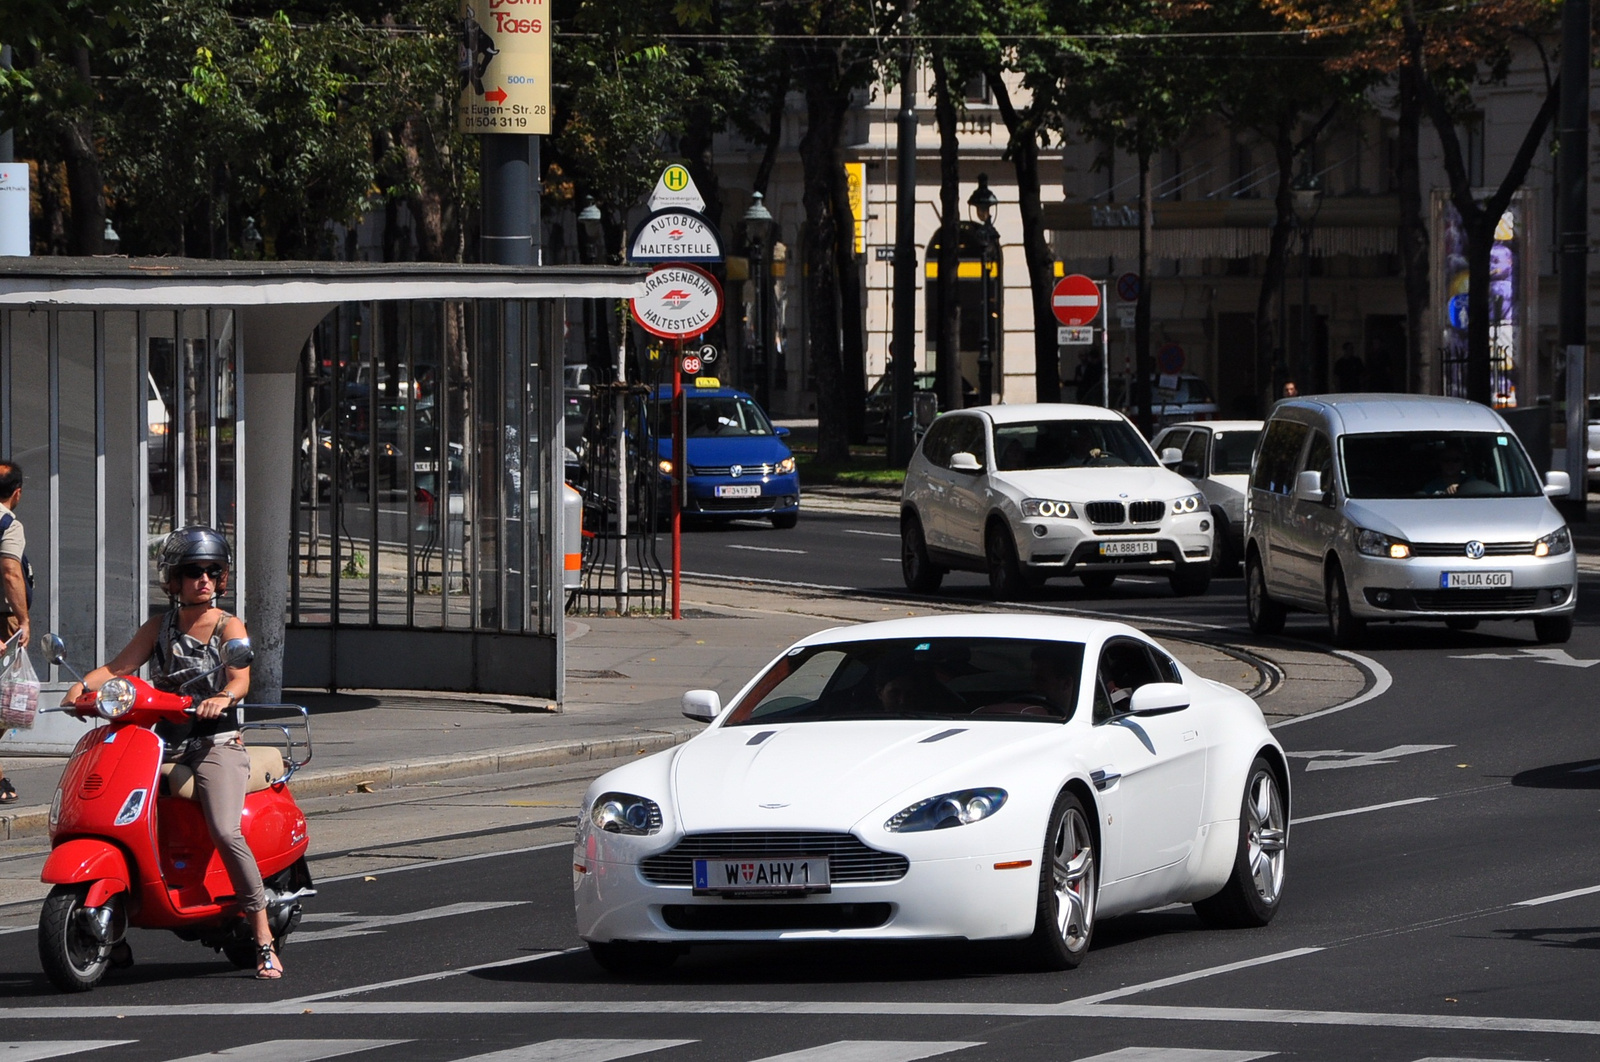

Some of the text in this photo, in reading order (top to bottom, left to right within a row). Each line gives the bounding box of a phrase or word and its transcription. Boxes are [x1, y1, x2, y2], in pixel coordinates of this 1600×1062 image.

[490, 12, 542, 33] Tass
[507, 76, 525, 84] 500
[534, 105, 546, 115] 28
[499, 117, 527, 127] 3119
[669, 171, 682, 187] H
[650, 216, 703, 234] AUTOBUS
[640, 244, 712, 254] HALTESTELLE
[643, 308, 710, 330] HALTESTELLE
[649, 349, 659, 360] N
[703, 347, 713, 360] 2
[684, 358, 699, 370] 68
[1105, 544, 1118, 553] AA
[1120, 543, 1141, 552] 8881
[1452, 574, 1507, 585] N UA 600
[725, 863, 739, 884] W
[756, 862, 794, 884] AHV
[801, 862, 809, 883] 1
